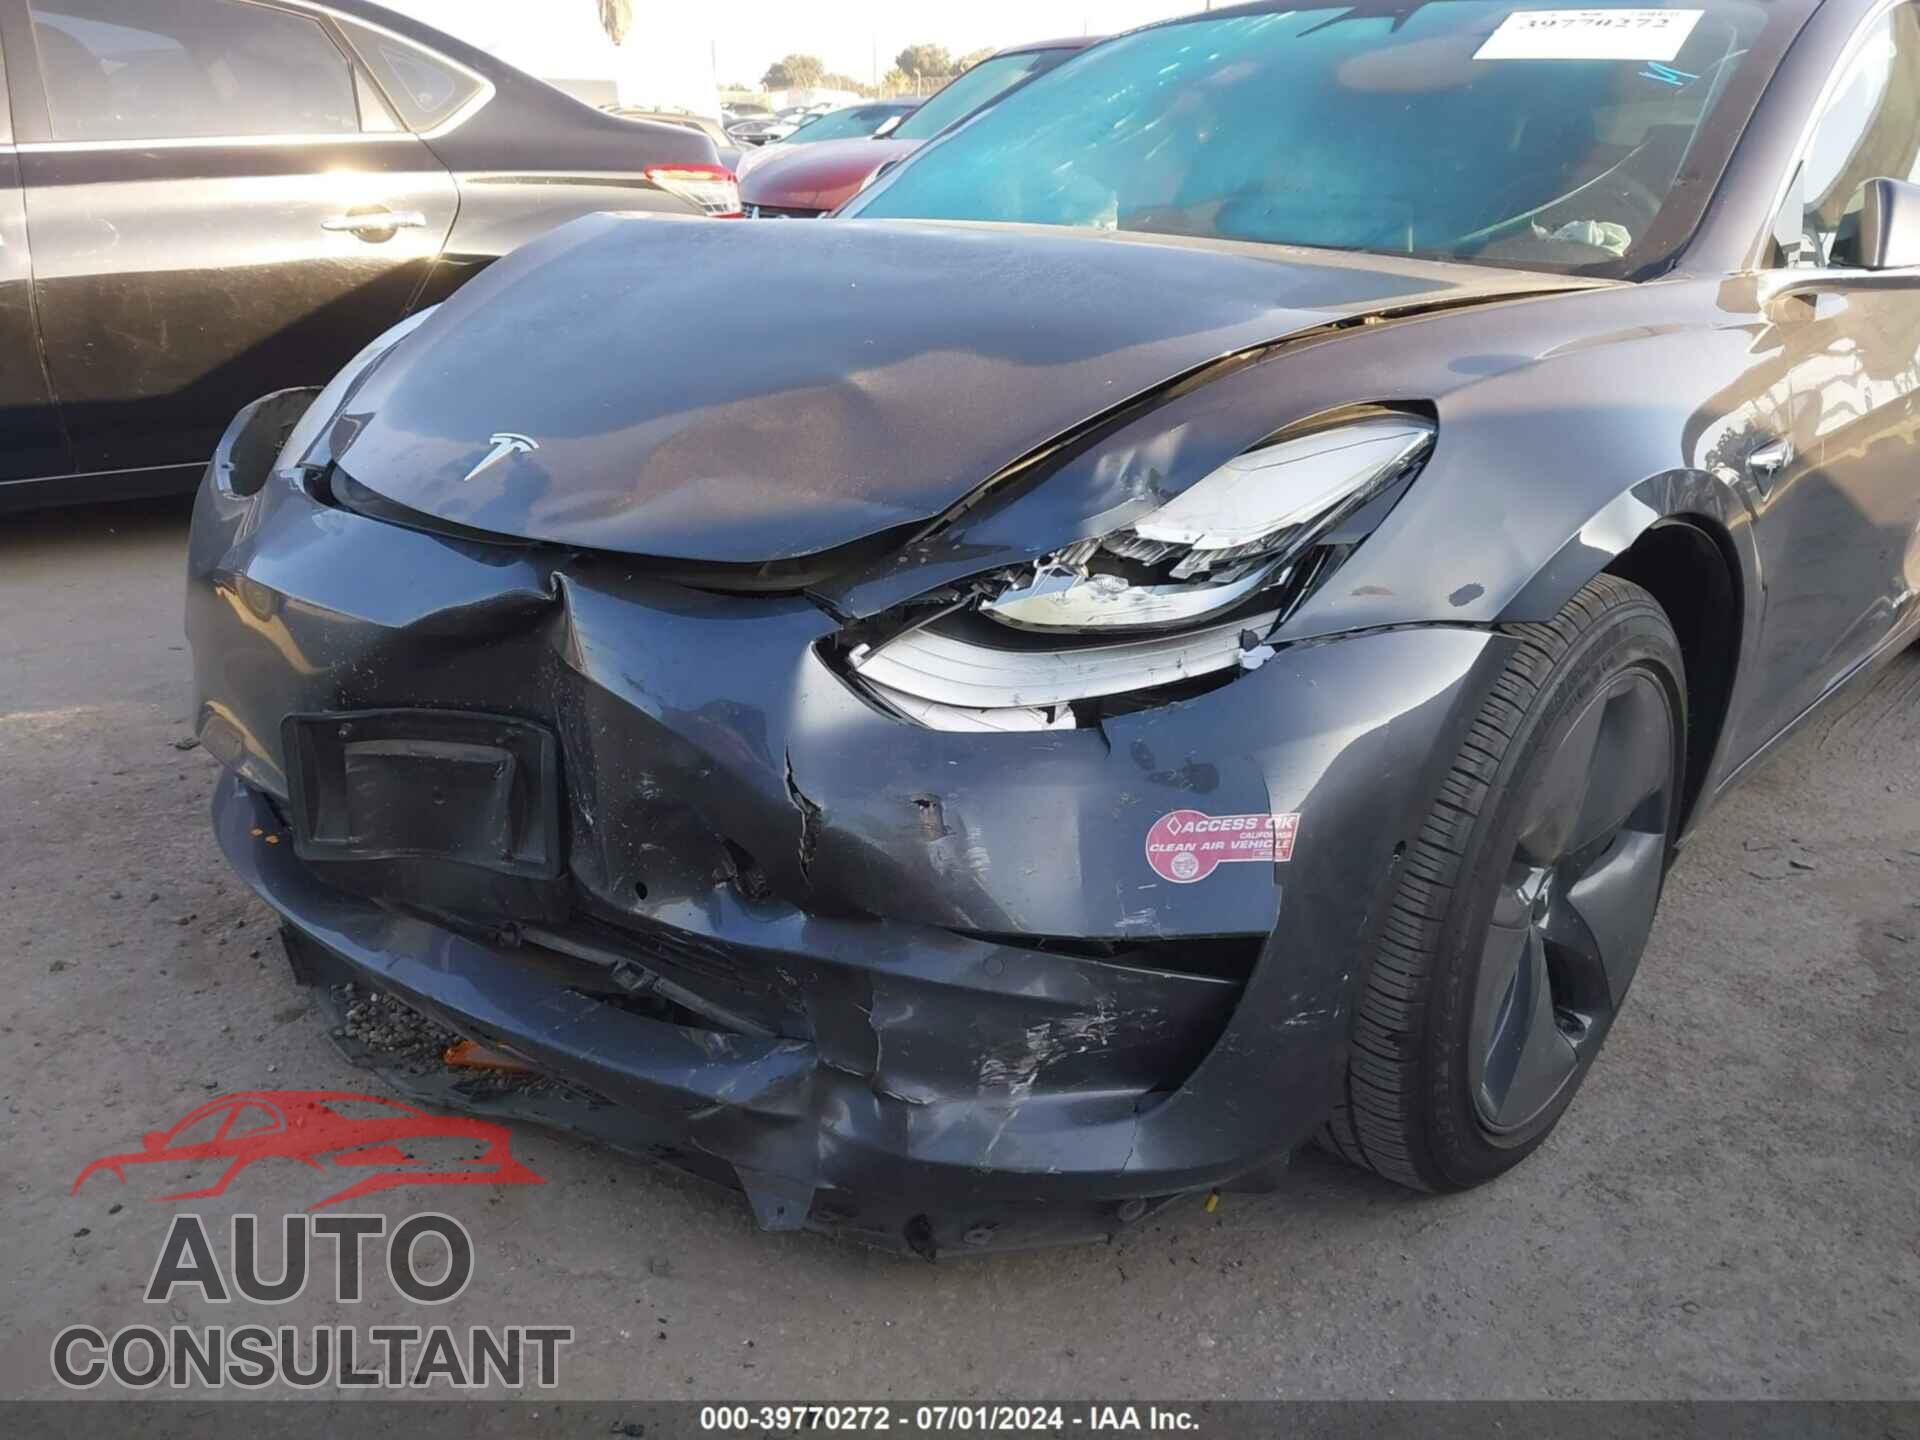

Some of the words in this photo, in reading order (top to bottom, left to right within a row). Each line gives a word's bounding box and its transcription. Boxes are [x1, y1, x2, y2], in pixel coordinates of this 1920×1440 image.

[1181, 818, 1258, 833] ACCESS
[1264, 816, 1295, 829] OK
[1150, 843, 1197, 852] CLEAN
[1200, 841, 1224, 850] AIR
[1231, 838, 1291, 849] VEHICLE
